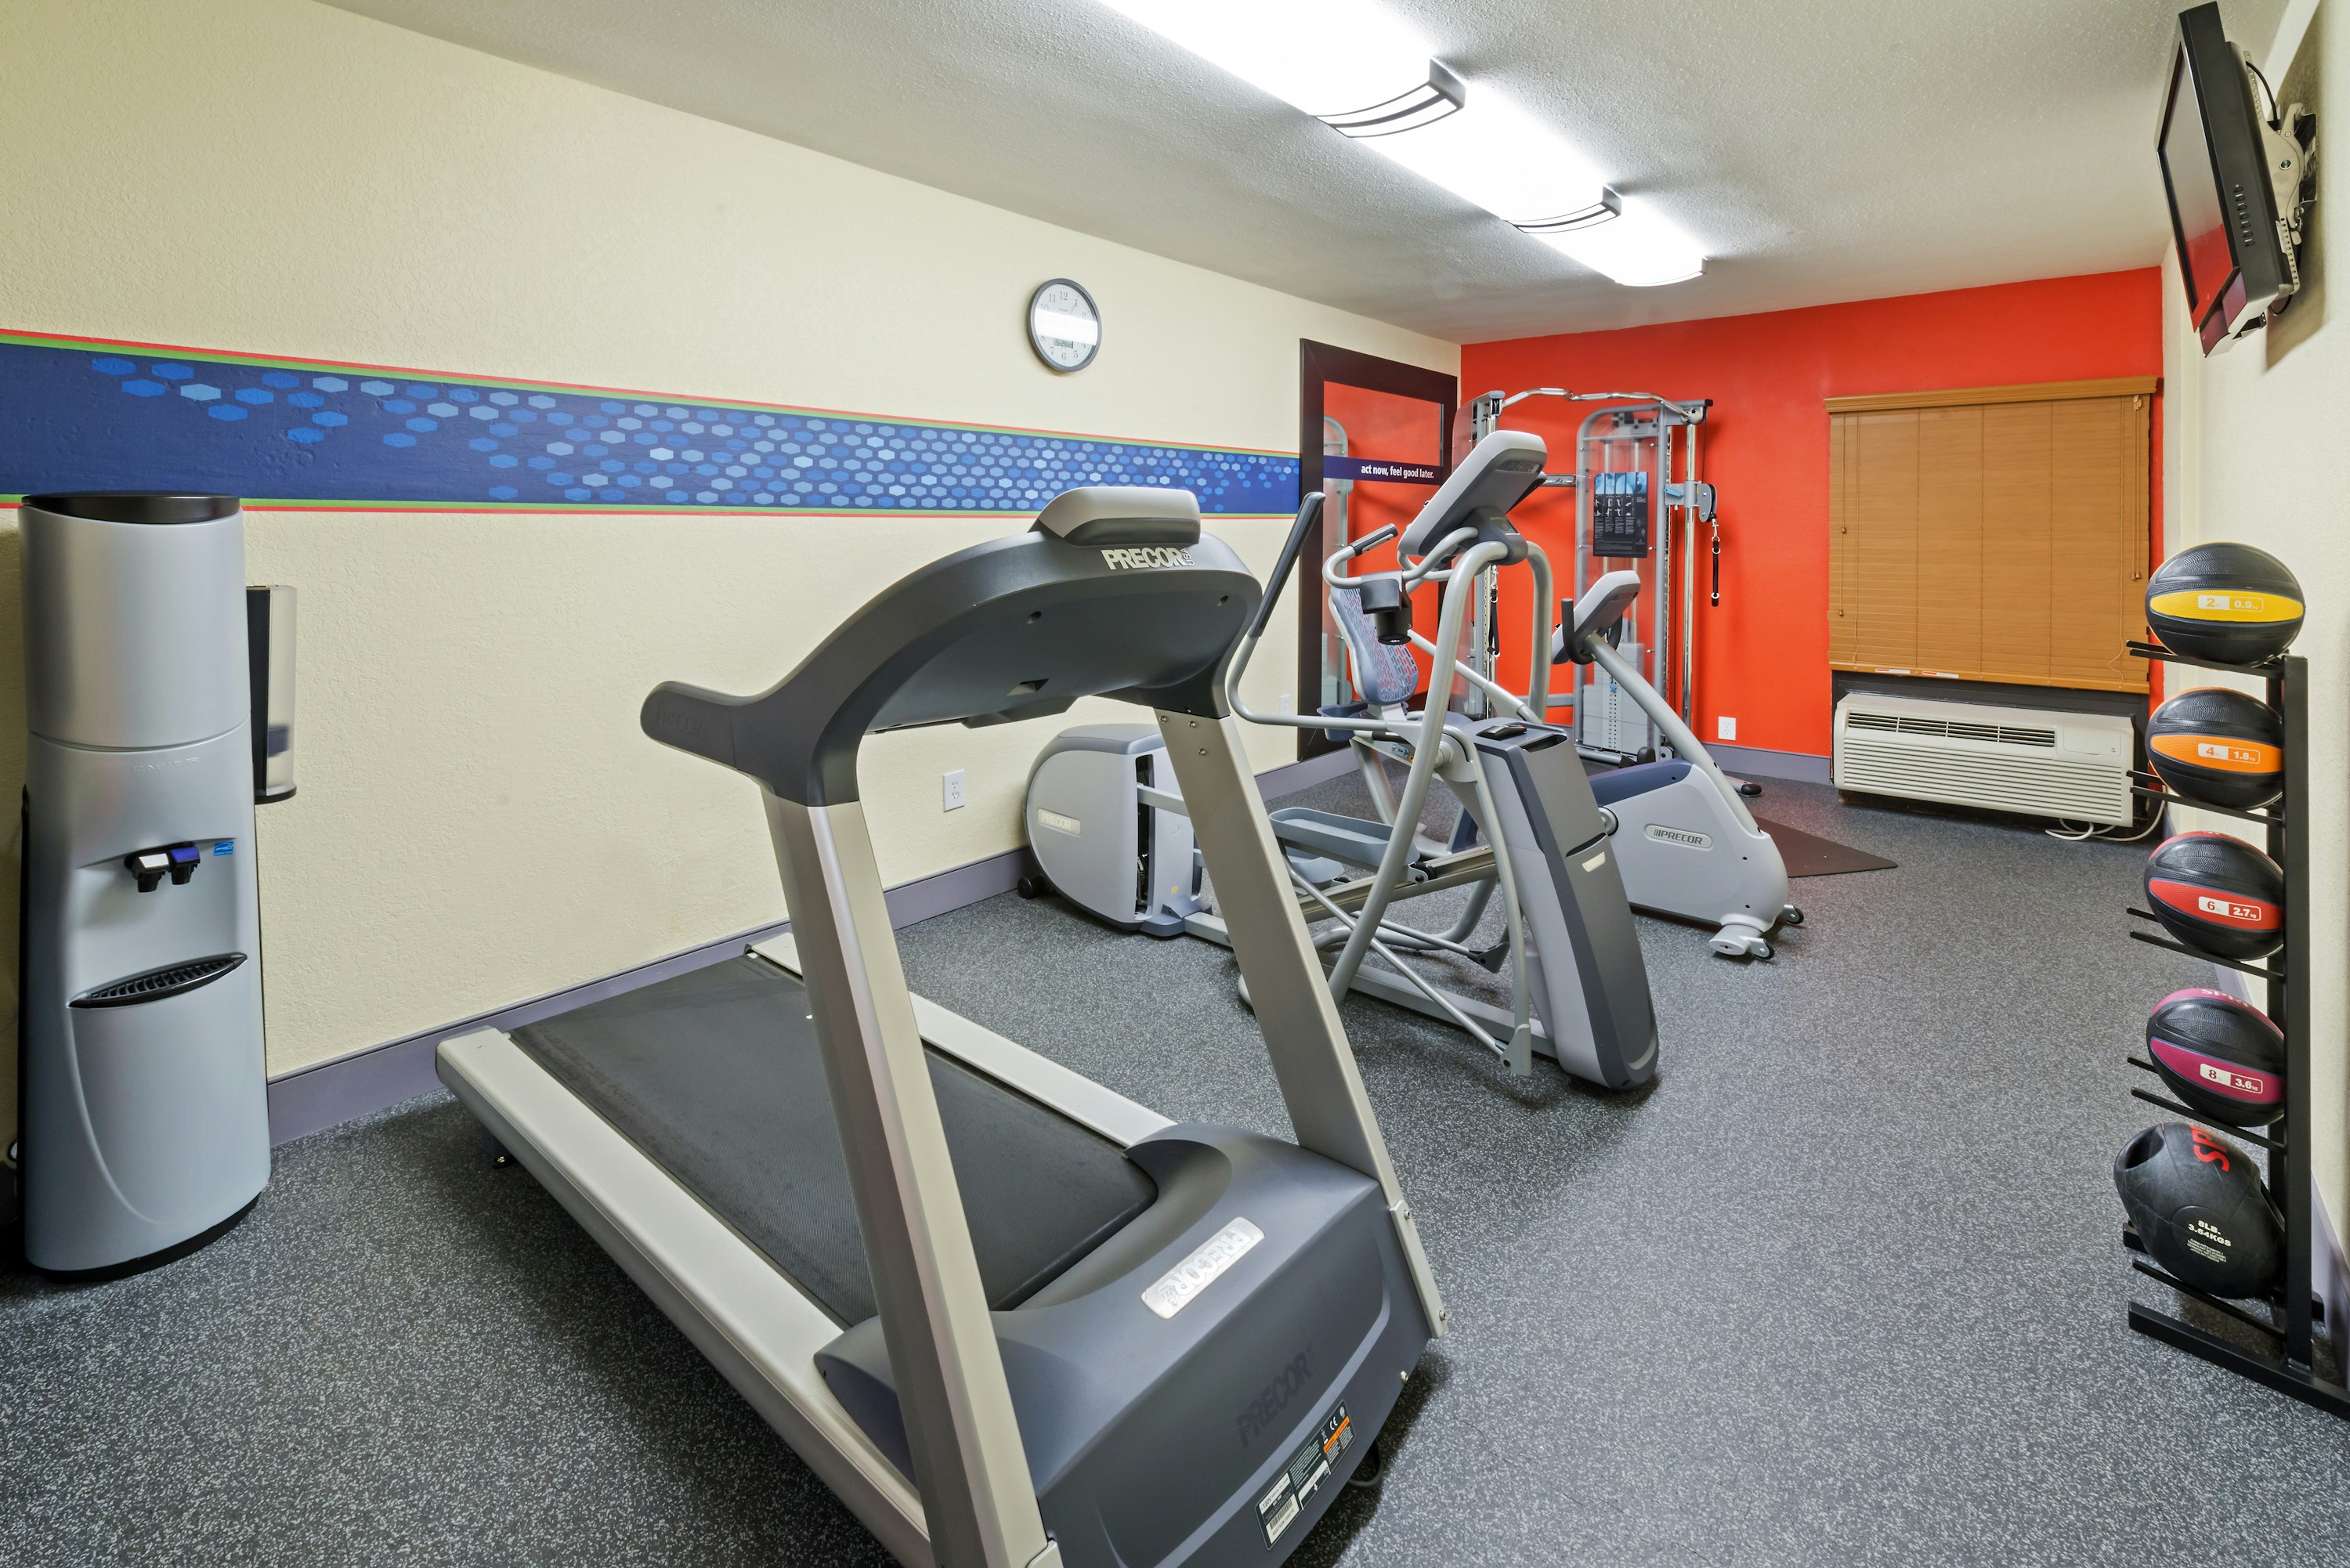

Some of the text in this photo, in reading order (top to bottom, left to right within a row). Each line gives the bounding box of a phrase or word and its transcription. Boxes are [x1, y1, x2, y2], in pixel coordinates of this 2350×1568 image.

[1049, 294, 1056, 303] 11
[1060, 291, 1068, 301] 12
[1050, 346, 1054, 356] 7
[1361, 464, 1434, 479] act now, feel good later.
[1101, 547, 1195, 570] PRECOR USA
[2207, 598, 2215, 607] 2
[2206, 746, 2214, 756] 4
[1041, 811, 1072, 830] PRECOR
[1660, 829, 1703, 845] PRECOR
[2207, 901, 2215, 911] 6
[2208, 1069, 2217, 1079] 8
[2188, 1223, 2232, 1247] 3.64KGS
[1163, 1227, 1252, 1295] PRECOR
[1236, 1351, 1314, 1449] PRECOR
